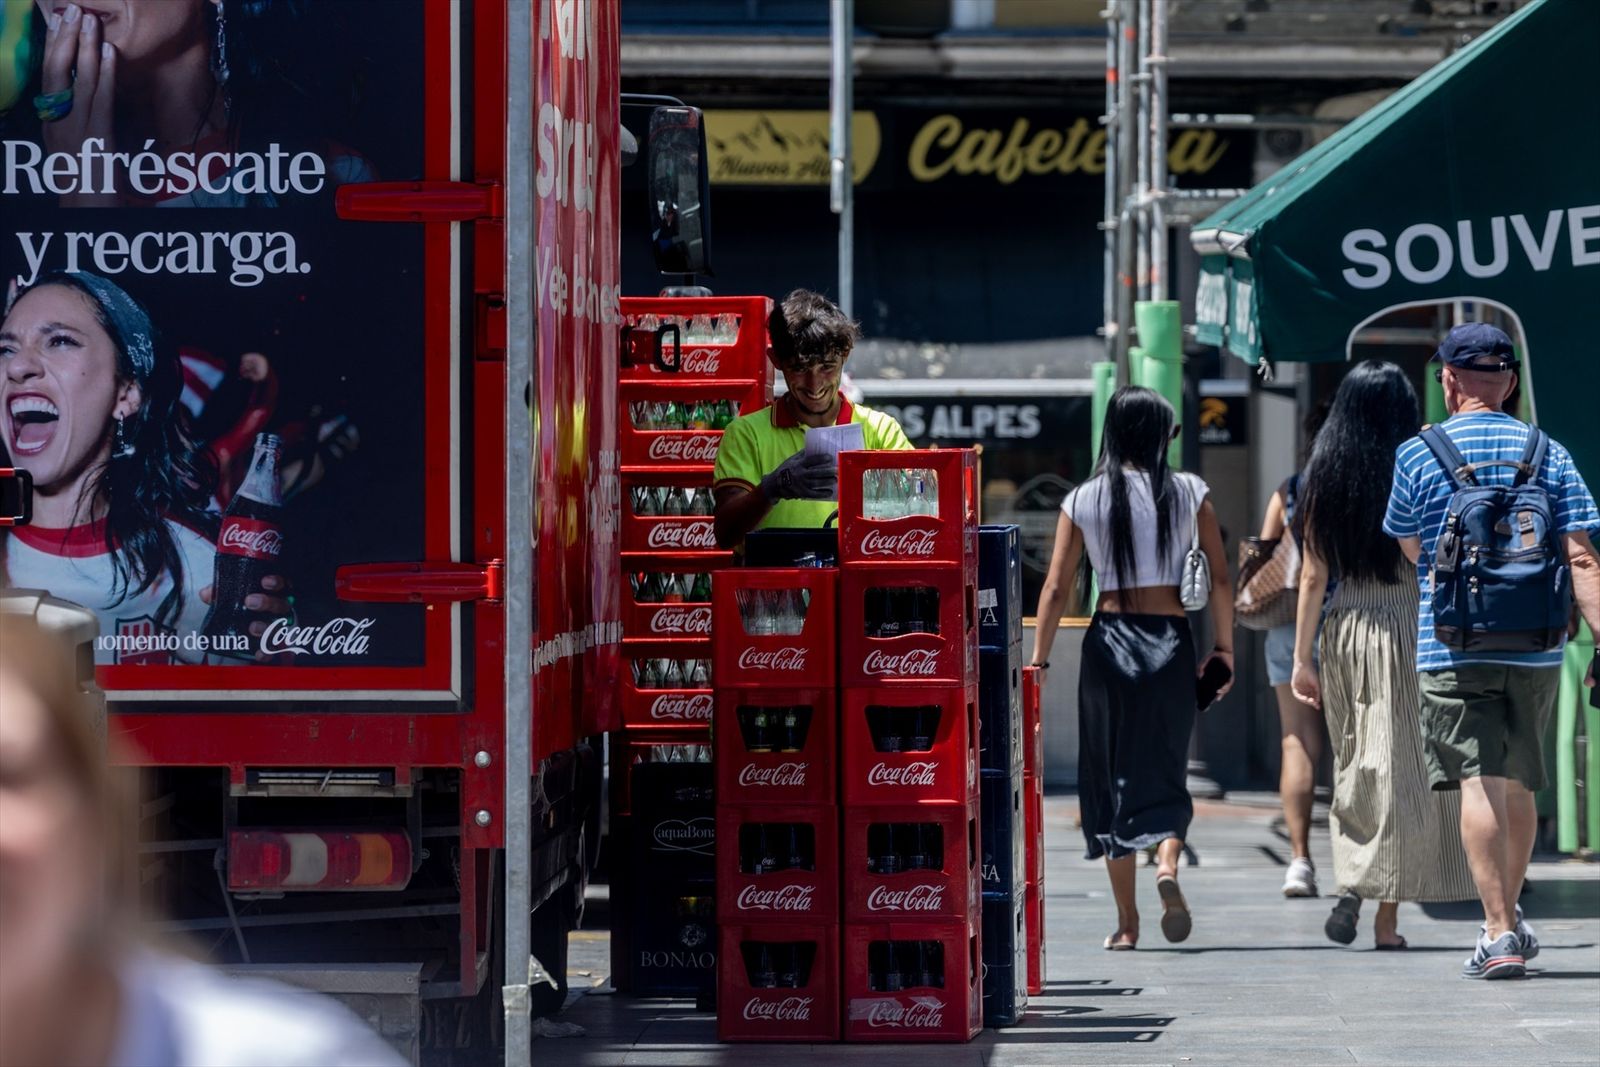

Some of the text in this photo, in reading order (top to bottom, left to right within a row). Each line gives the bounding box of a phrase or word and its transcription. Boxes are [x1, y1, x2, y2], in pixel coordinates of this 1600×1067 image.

[908, 114, 1228, 184] Cafetea
[3, 137, 326, 195] Refréscate
[16, 231, 312, 288] y recarga.
[1341, 204, 1600, 290] SOUVE
[928, 404, 1041, 438] ALPES
[861, 529, 938, 555] Coca-Cola
[183, 630, 210, 651] de
[212, 635, 250, 651] una
[260, 617, 376, 655] Coca-Cola
[738, 646, 810, 671] Coca-Cola
[863, 649, 941, 675] Coca-Cola
[739, 762, 809, 786] Coca-Cola
[868, 761, 940, 786] Coca-Cola
[737, 884, 816, 911] Coca-Cola
[867, 884, 946, 911] Coca-Cola
[743, 996, 815, 1021] Coca-Cola
